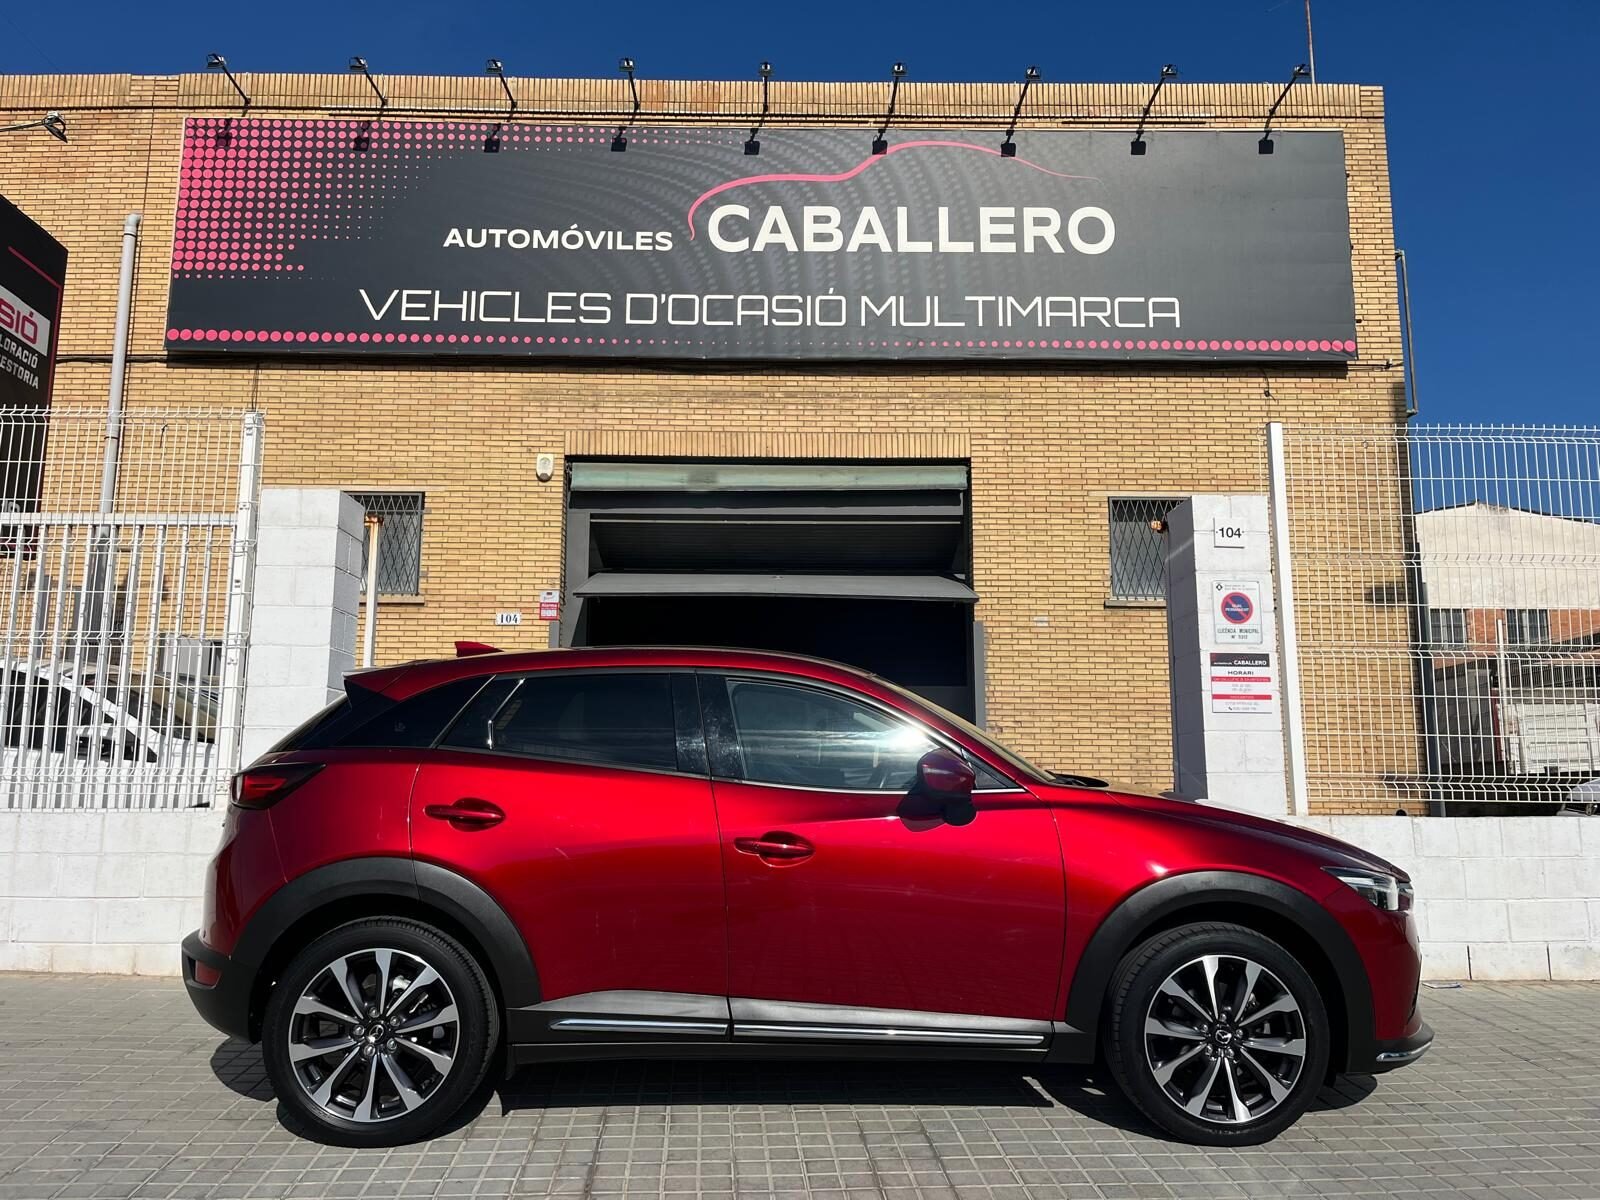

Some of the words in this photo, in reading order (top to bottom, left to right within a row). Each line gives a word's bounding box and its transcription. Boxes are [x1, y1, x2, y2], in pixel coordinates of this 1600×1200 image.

[443, 223, 673, 252] AUTOMÓVILES
[707, 204, 1116, 255] CABALLERO
[359, 288, 611, 324] VEHICLES
[625, 287, 847, 327] D'OCASIÓ
[0, 354, 39, 390] ESTORIA
[1218, 527, 1242, 538] 104
[500, 614, 518, 624] 104
